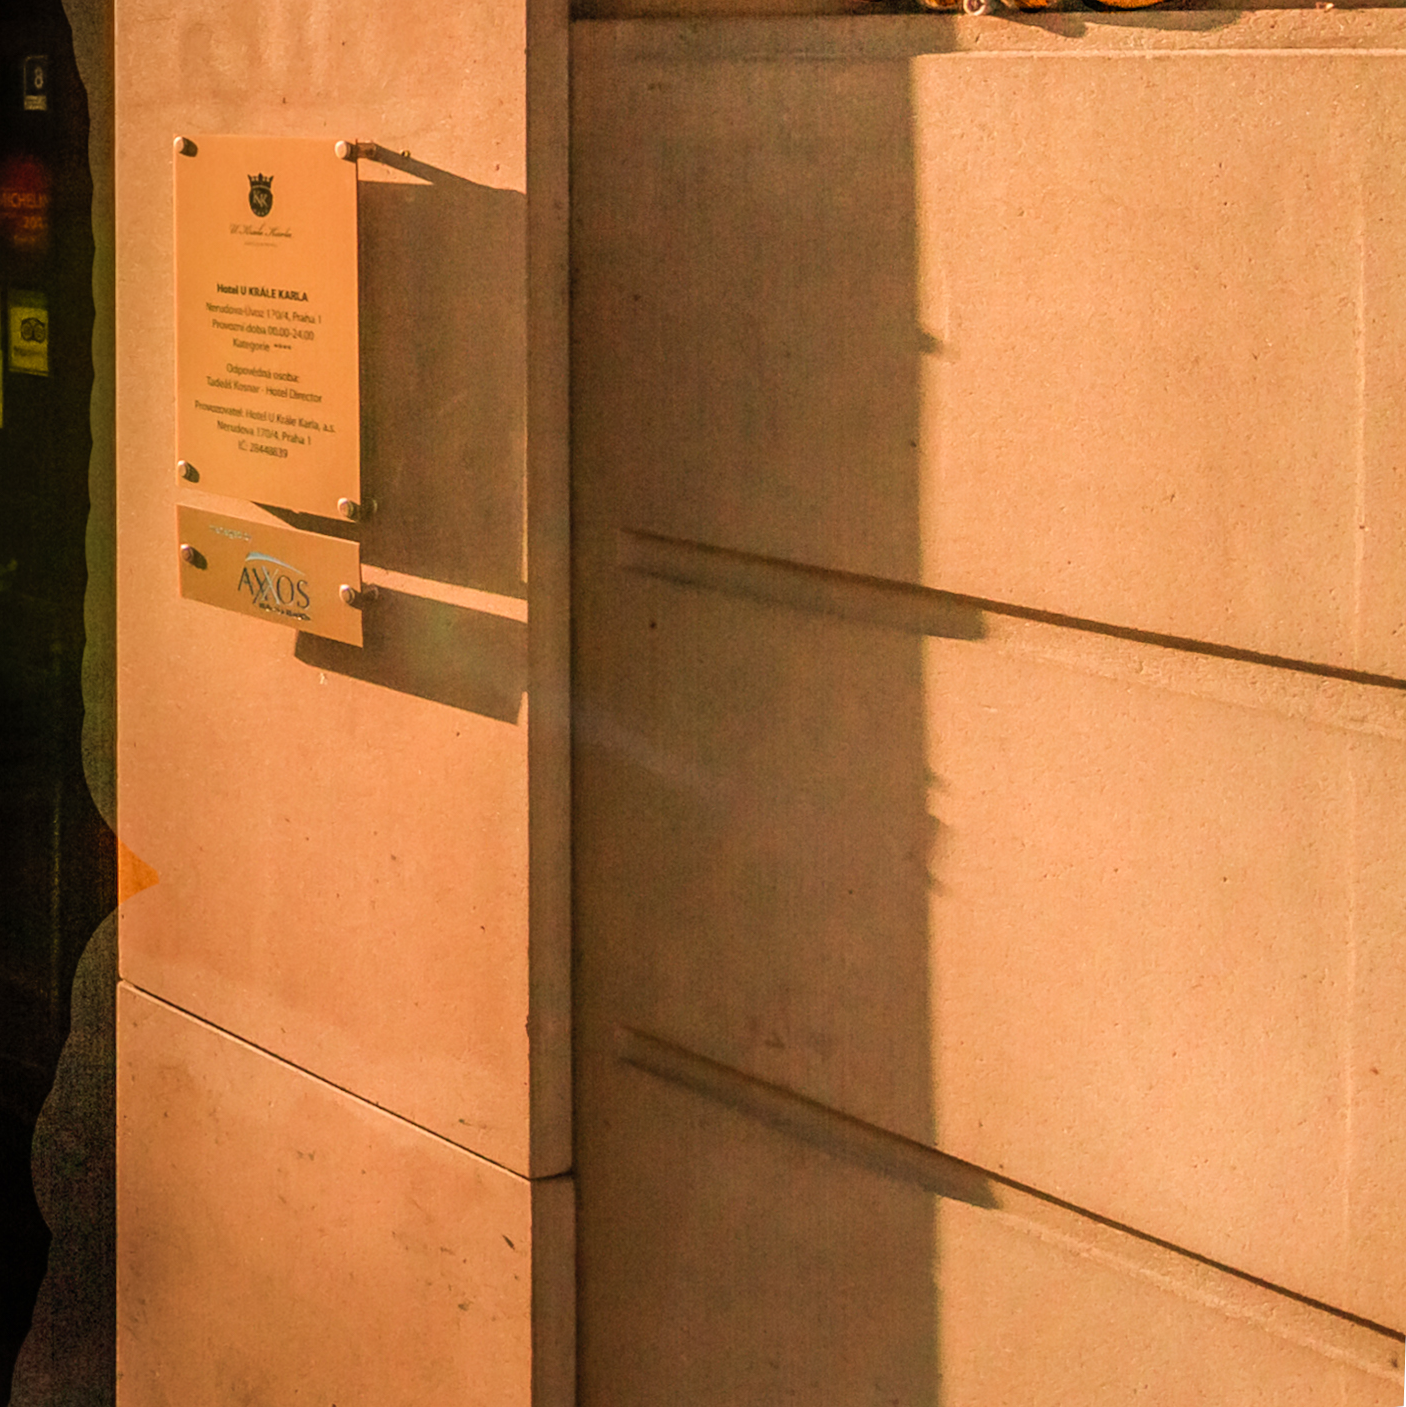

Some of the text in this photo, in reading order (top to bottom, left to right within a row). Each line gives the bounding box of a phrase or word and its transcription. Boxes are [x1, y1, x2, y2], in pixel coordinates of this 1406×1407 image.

[217, 284, 309, 302] Hotel U KRÁLE KARLA
[293, 311, 316, 324] Praha
[246, 324, 266, 335] doba
[233, 338, 270, 353] Kategorie
[266, 387, 288, 398] Hotel
[290, 389, 322, 403] Director
[246, 409, 267, 422] Hotel
[268, 413, 275, 423] U
[217, 420, 254, 436] Nerudova
[282, 431, 305, 445] Praha
